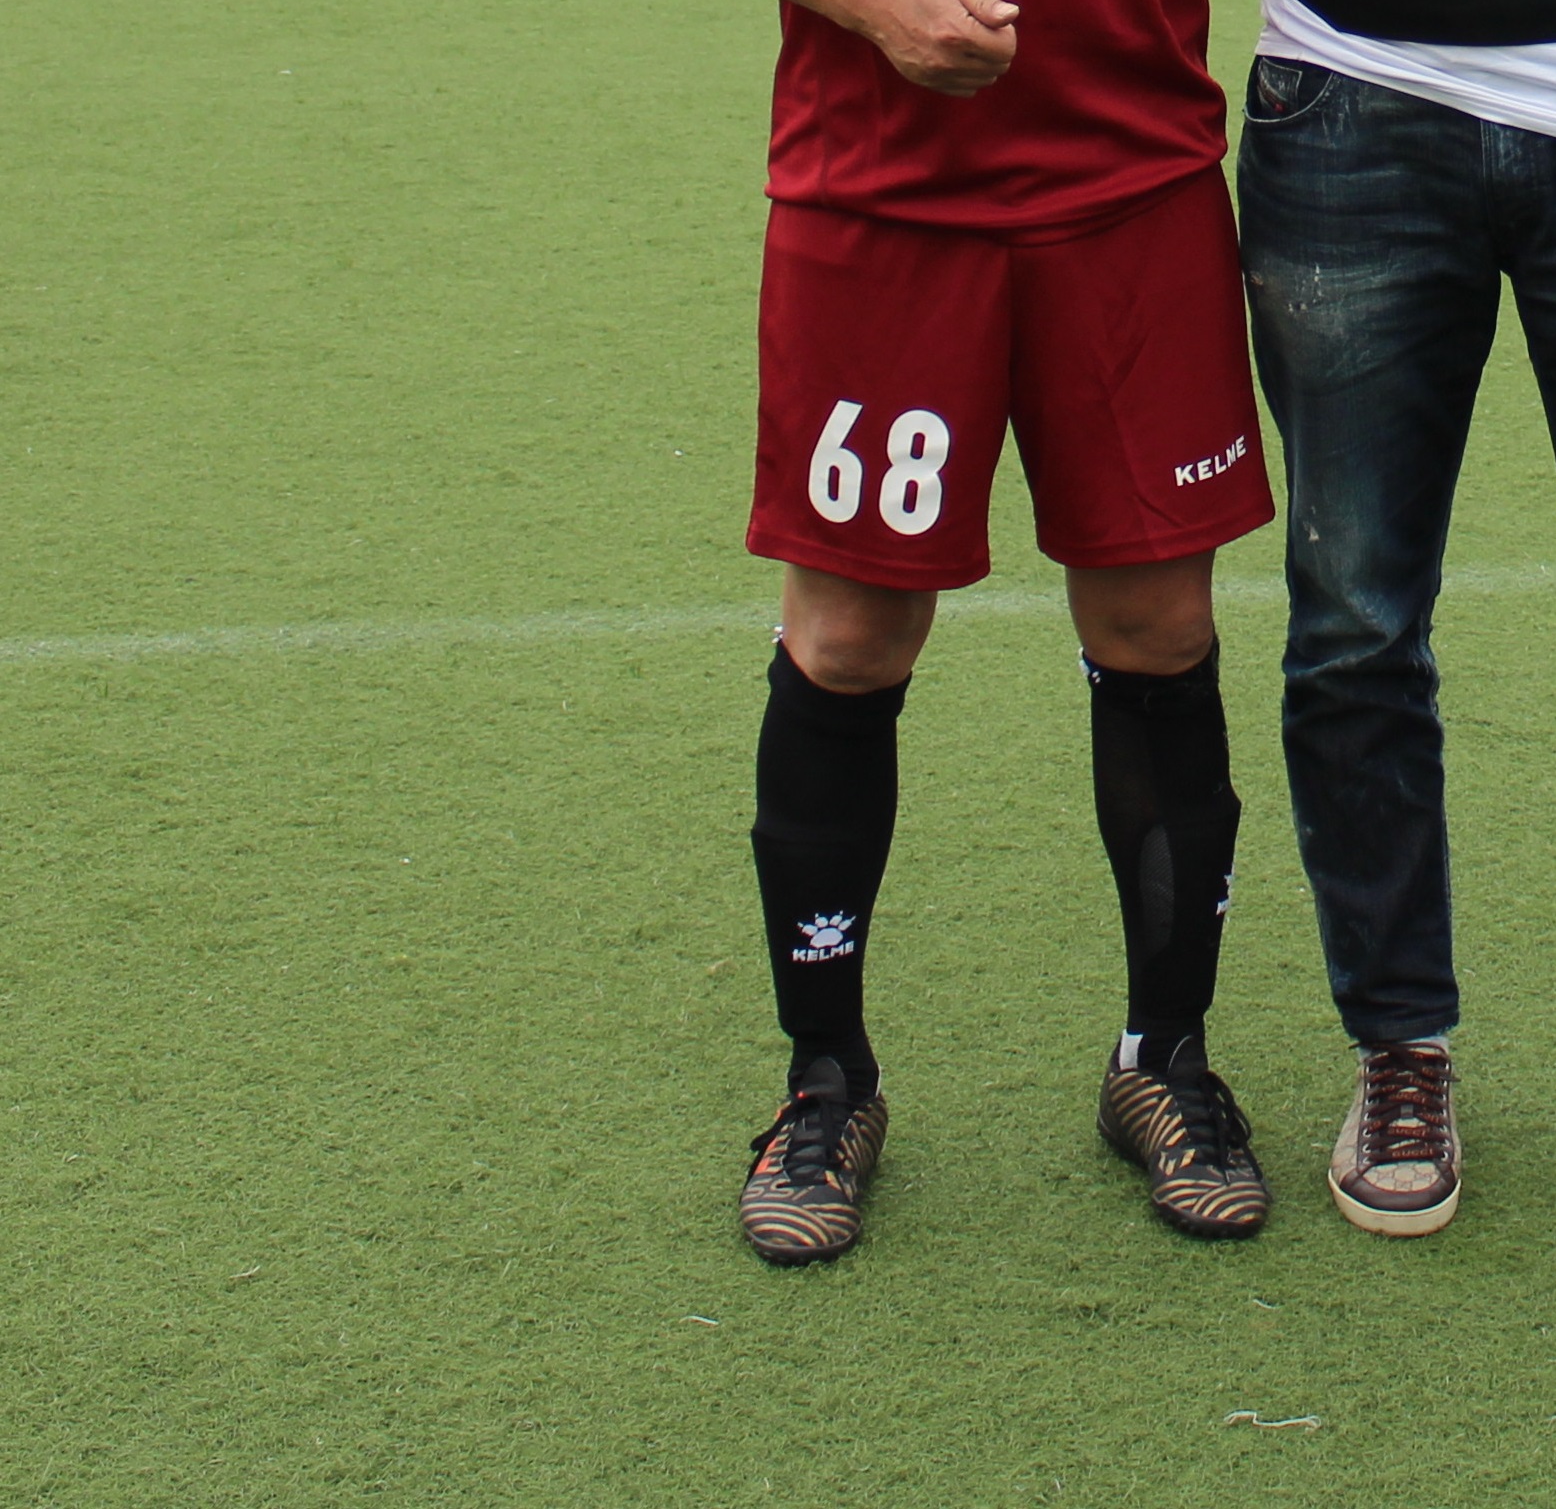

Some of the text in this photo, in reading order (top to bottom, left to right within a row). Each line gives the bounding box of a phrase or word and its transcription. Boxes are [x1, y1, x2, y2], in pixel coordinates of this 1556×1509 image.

[808, 399, 951, 536] 68
[1174, 435, 1248, 487] KELME
[792, 939, 855, 962] KELME
